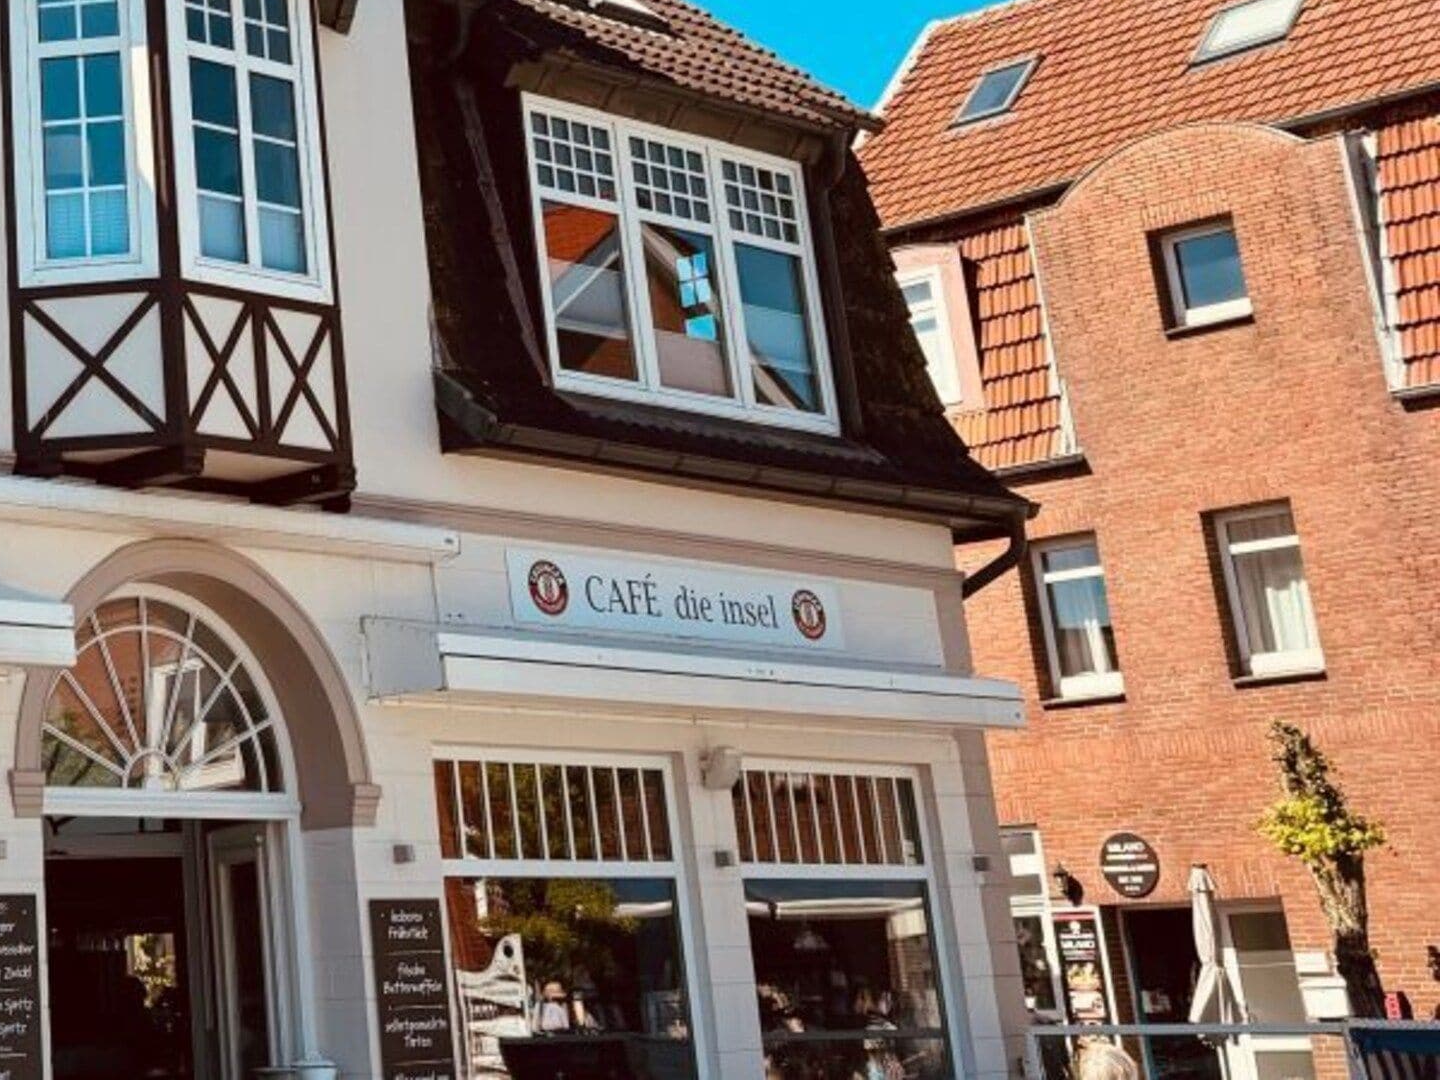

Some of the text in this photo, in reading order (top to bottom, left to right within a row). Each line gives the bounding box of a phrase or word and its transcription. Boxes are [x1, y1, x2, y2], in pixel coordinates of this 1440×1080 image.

[585, 572, 662, 618] CAFÉ
[674, 584, 714, 623] die
[719, 591, 779, 630] insel
